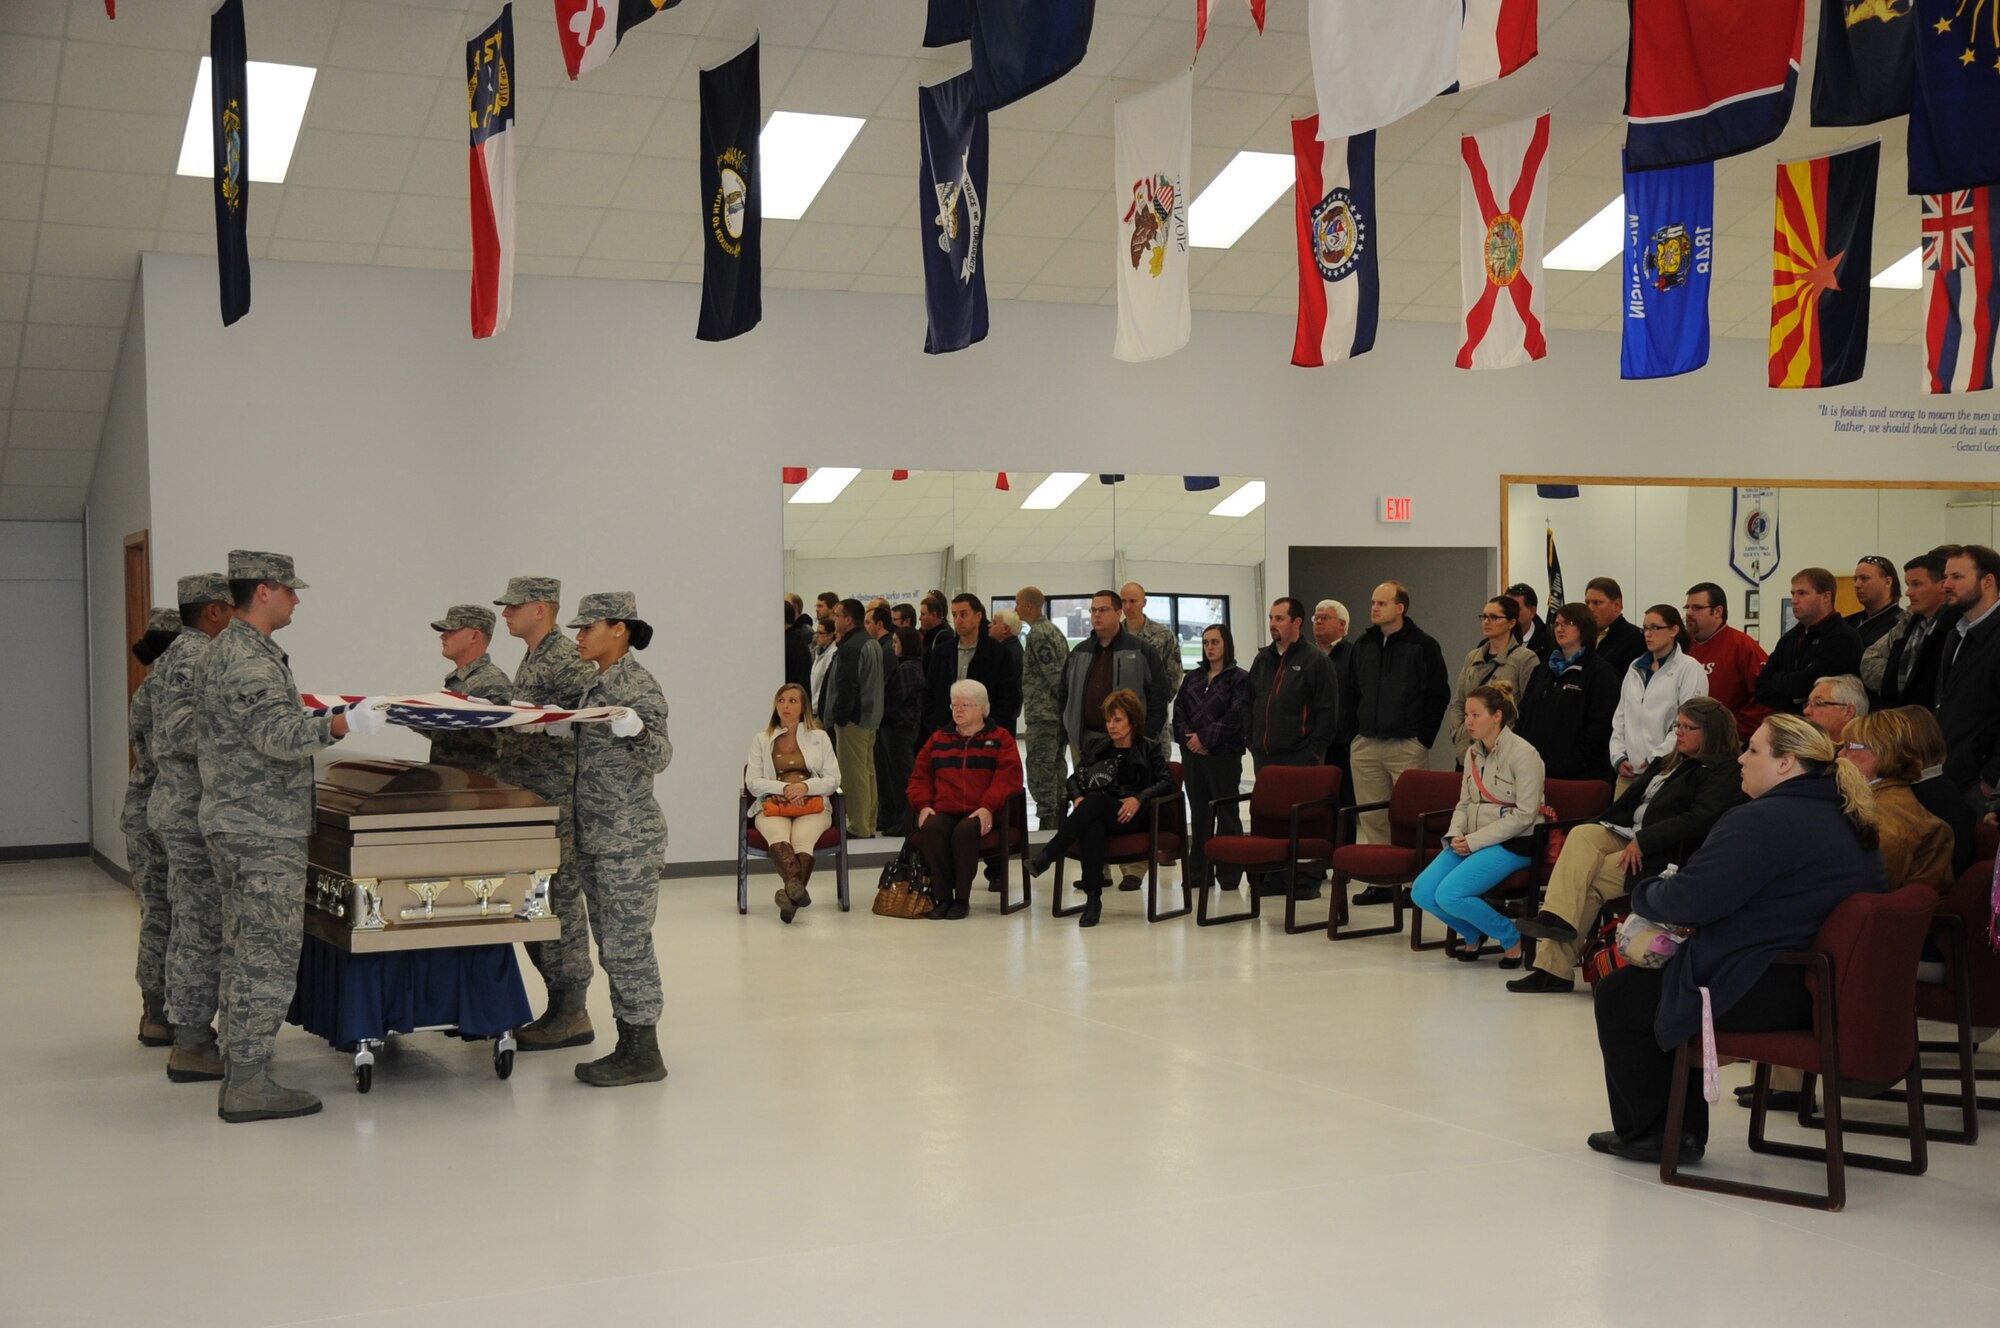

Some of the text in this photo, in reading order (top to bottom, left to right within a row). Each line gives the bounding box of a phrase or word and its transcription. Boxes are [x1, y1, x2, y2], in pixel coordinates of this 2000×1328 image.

[1830, 405, 1838, 416] is
[1840, 405, 1868, 419] foolish
[1869, 406, 1888, 418] and
[1889, 410, 1915, 421] wrong
[1917, 409, 1926, 419] to
[1928, 411, 1955, 420] mourn
[1957, 409, 1972, 421] the
[1973, 412, 1991, 421] men
[1834, 420, 1998, 436] Rather, we should thank God that such
[1956, 441, 1982, 451] General
[1387, 498, 1411, 520] EXIT
